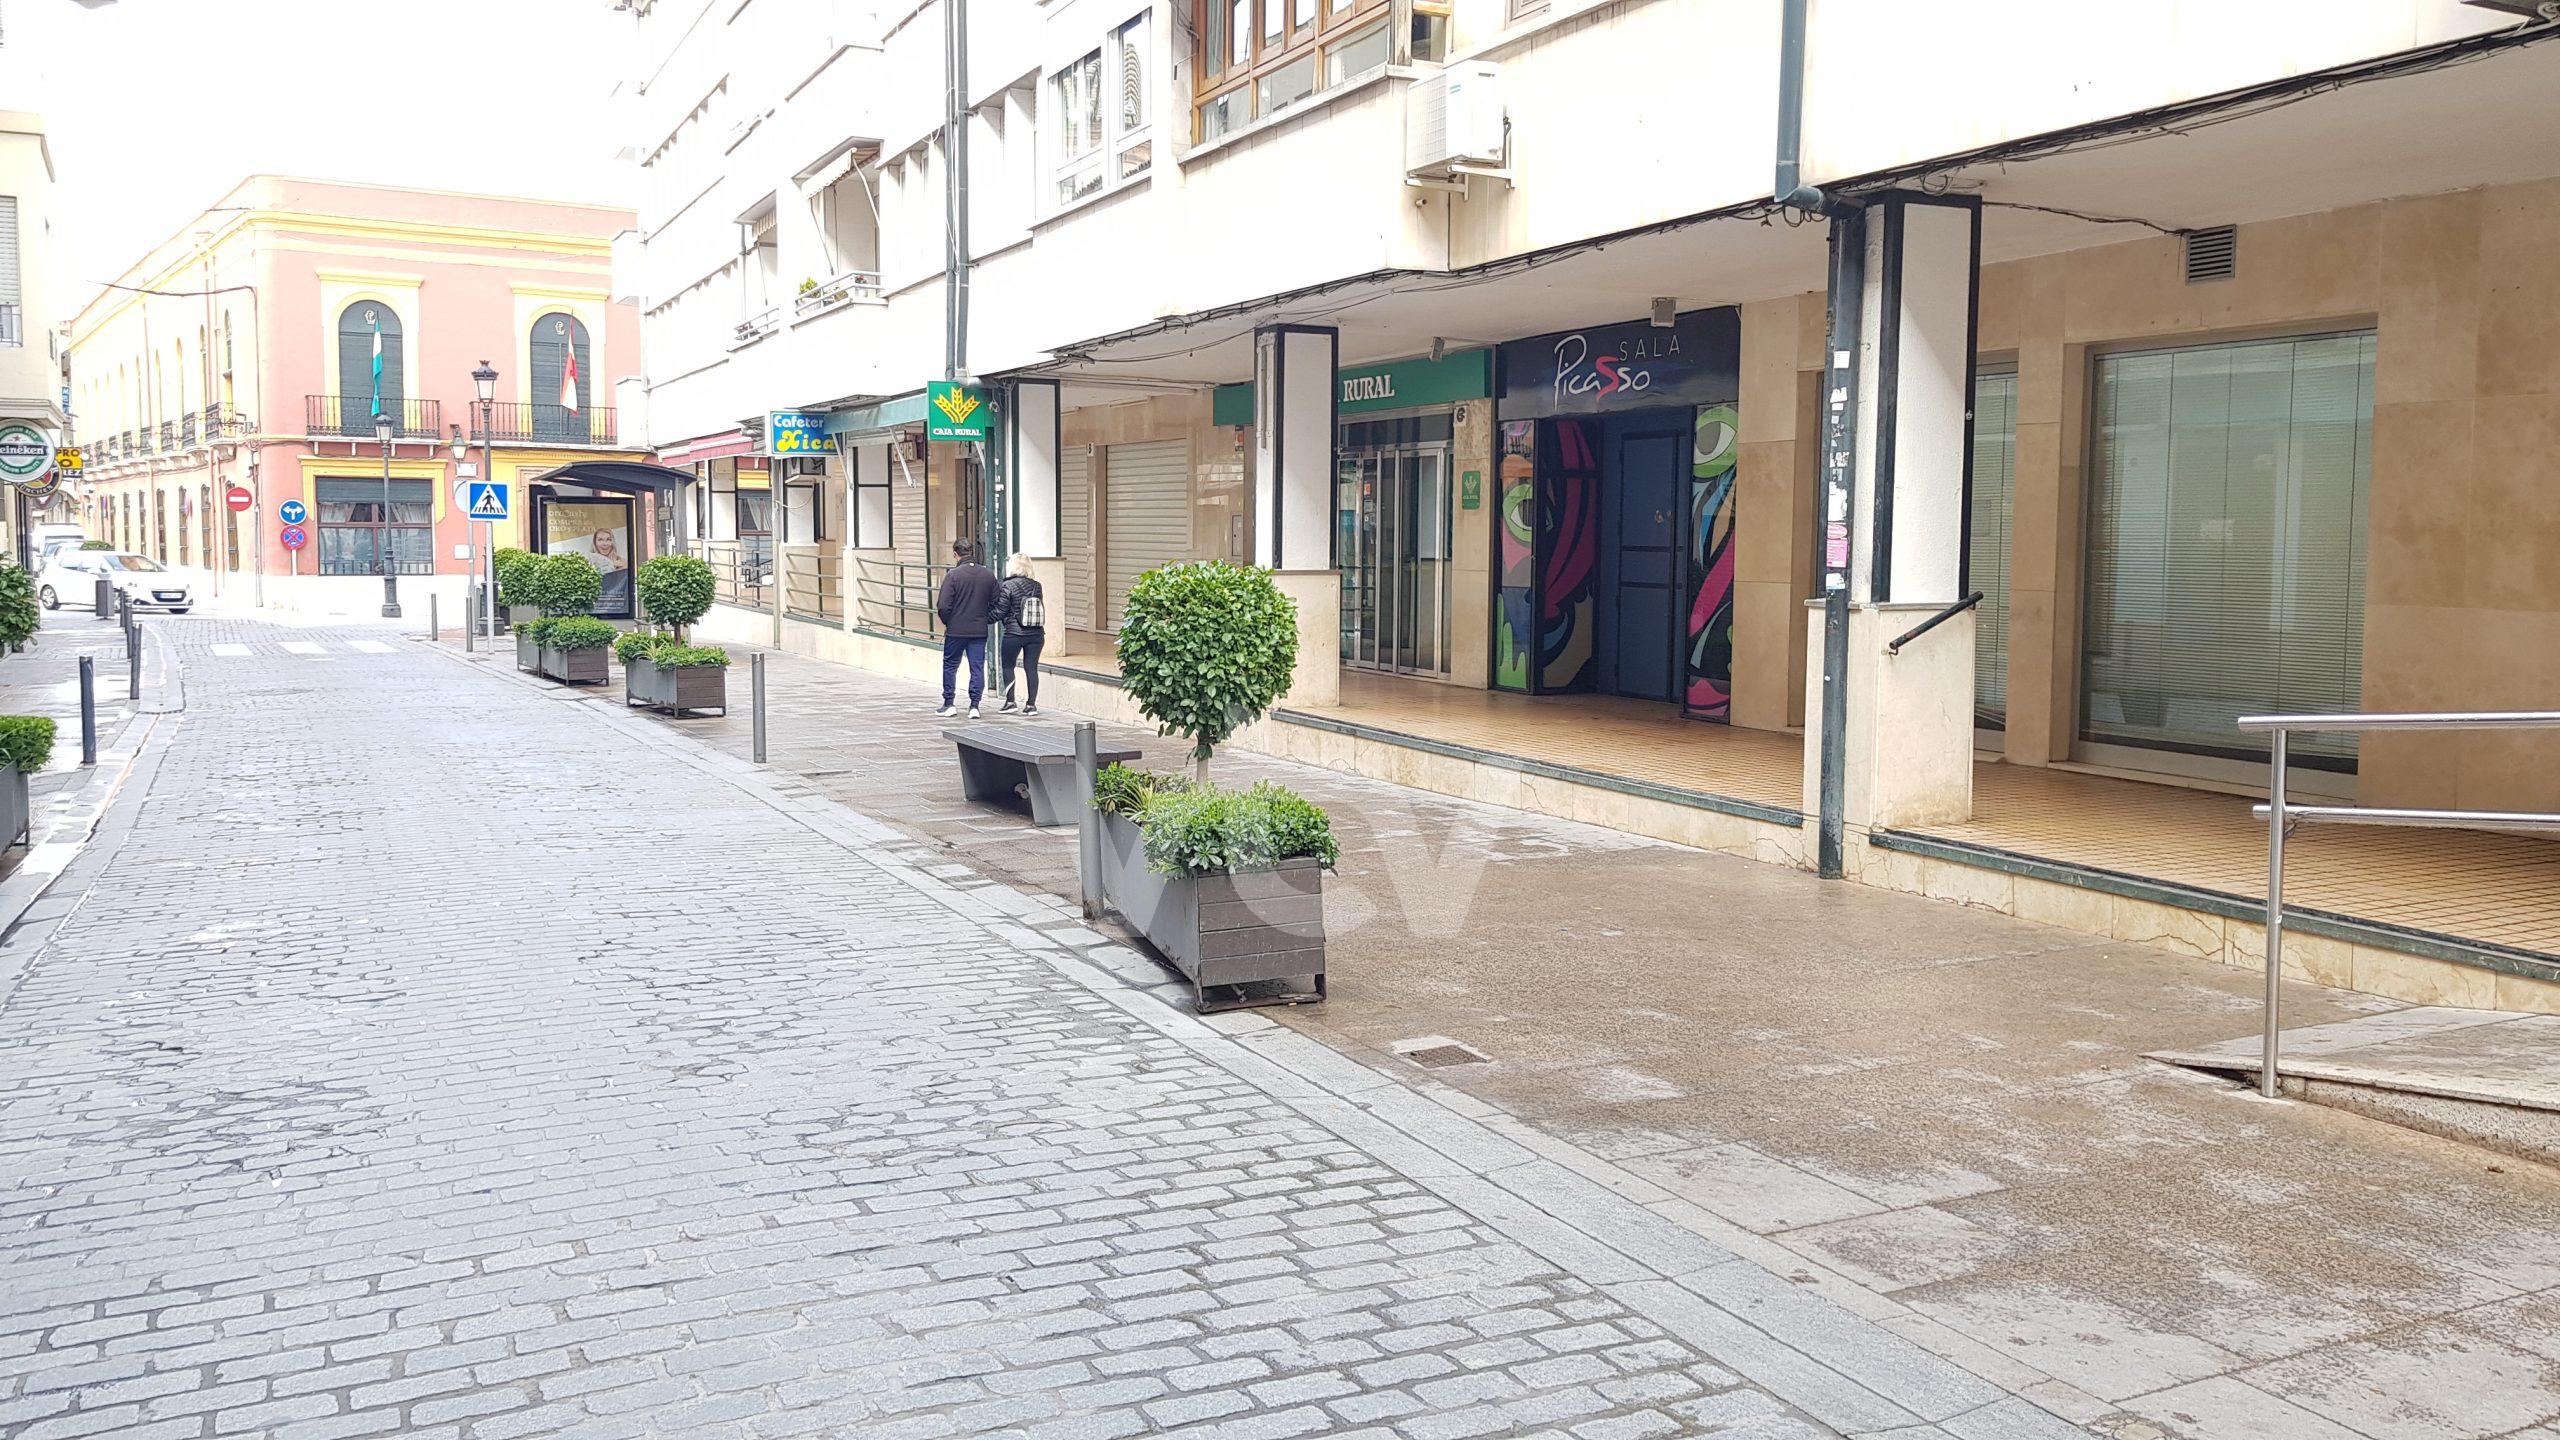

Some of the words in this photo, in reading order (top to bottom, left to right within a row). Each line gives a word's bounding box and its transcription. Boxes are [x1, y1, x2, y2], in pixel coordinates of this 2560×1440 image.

[1619, 334, 1680, 361] SALA
[1343, 374, 1395, 402] RURAL
[773, 415, 824, 428] Cafeter
[933, 428, 953, 436] CAJA
[955, 428, 982, 436] RURAL
[0, 446, 45, 455] eineken
